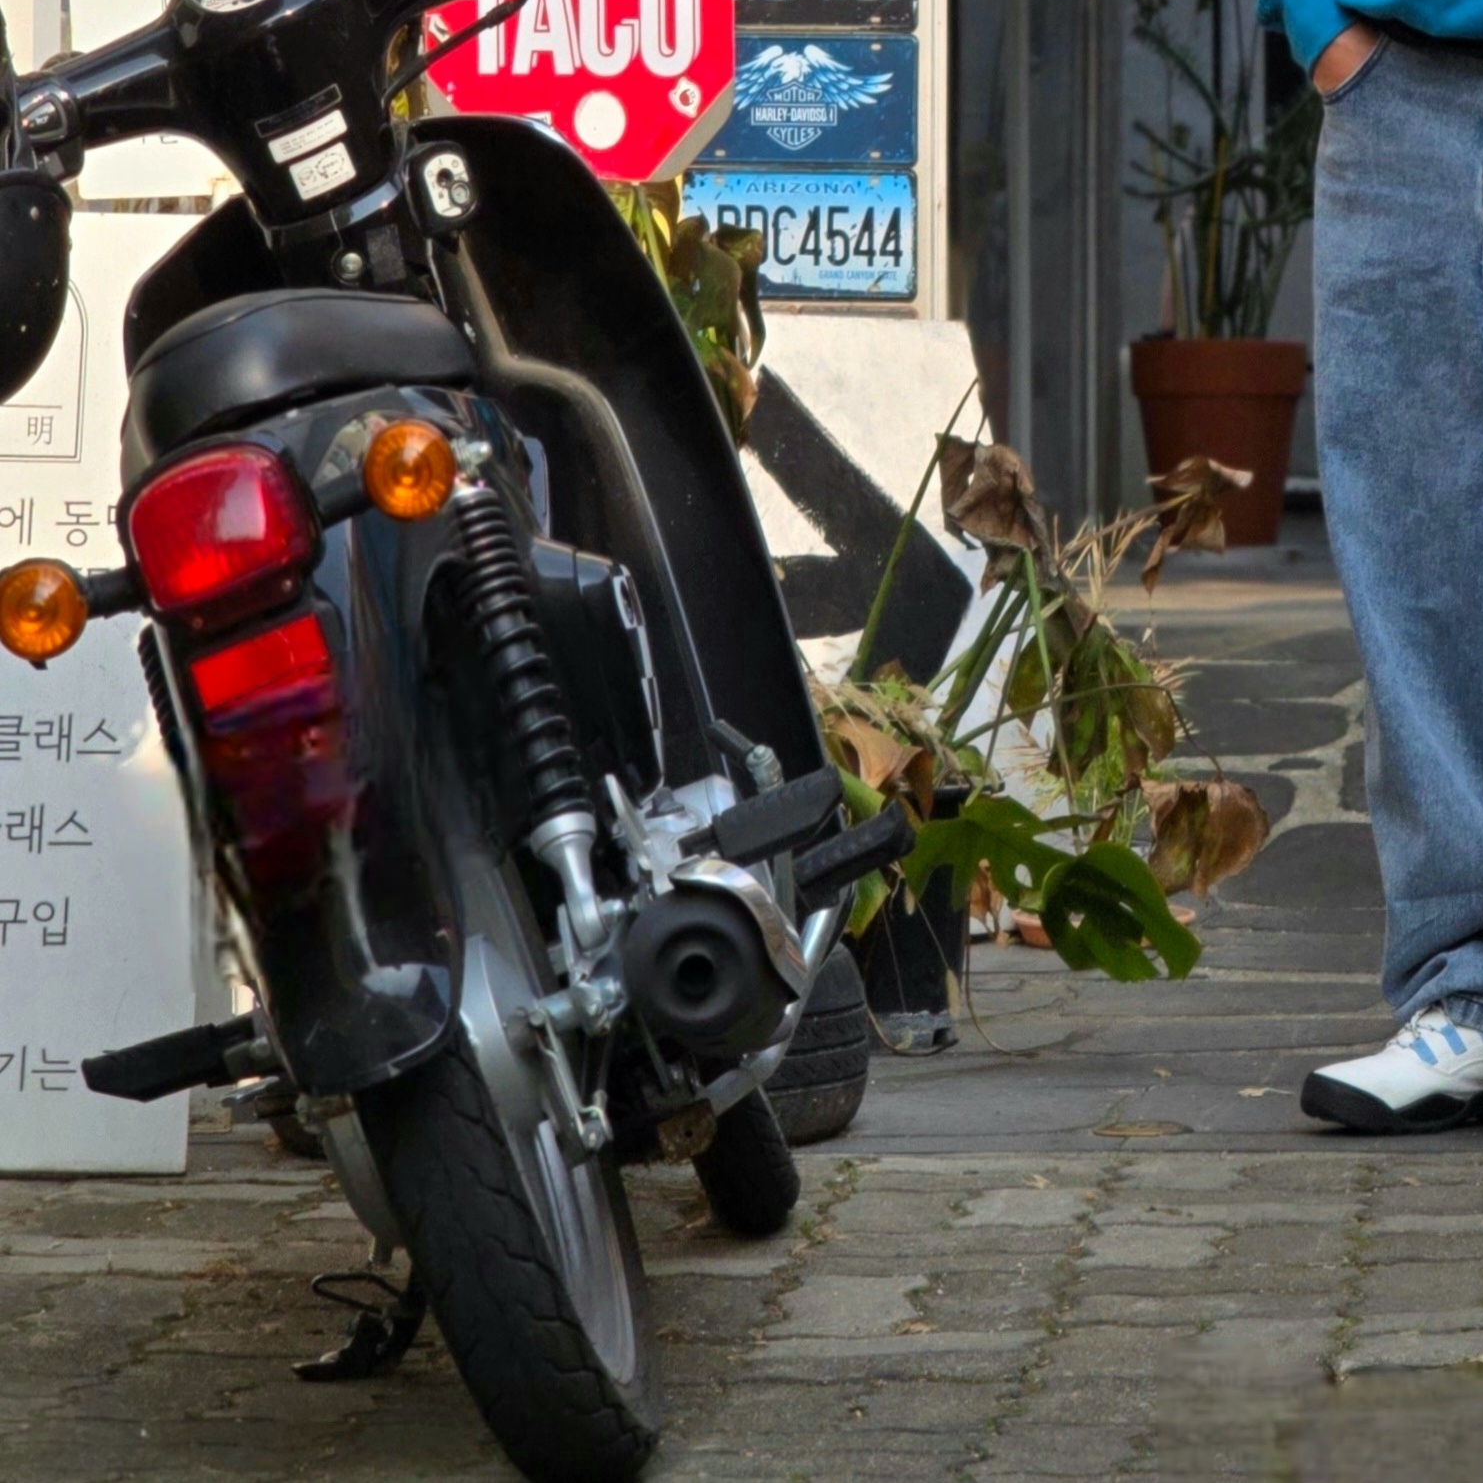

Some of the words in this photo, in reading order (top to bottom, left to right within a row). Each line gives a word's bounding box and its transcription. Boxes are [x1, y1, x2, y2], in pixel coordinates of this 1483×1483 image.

[773, 86, 816, 102] MOTOR
[773, 127, 815, 146] CYCLES
[745, 181, 857, 195] ARIZONA
[26, 415, 54, 446] 明
[0, 803, 94, 855] 래스
